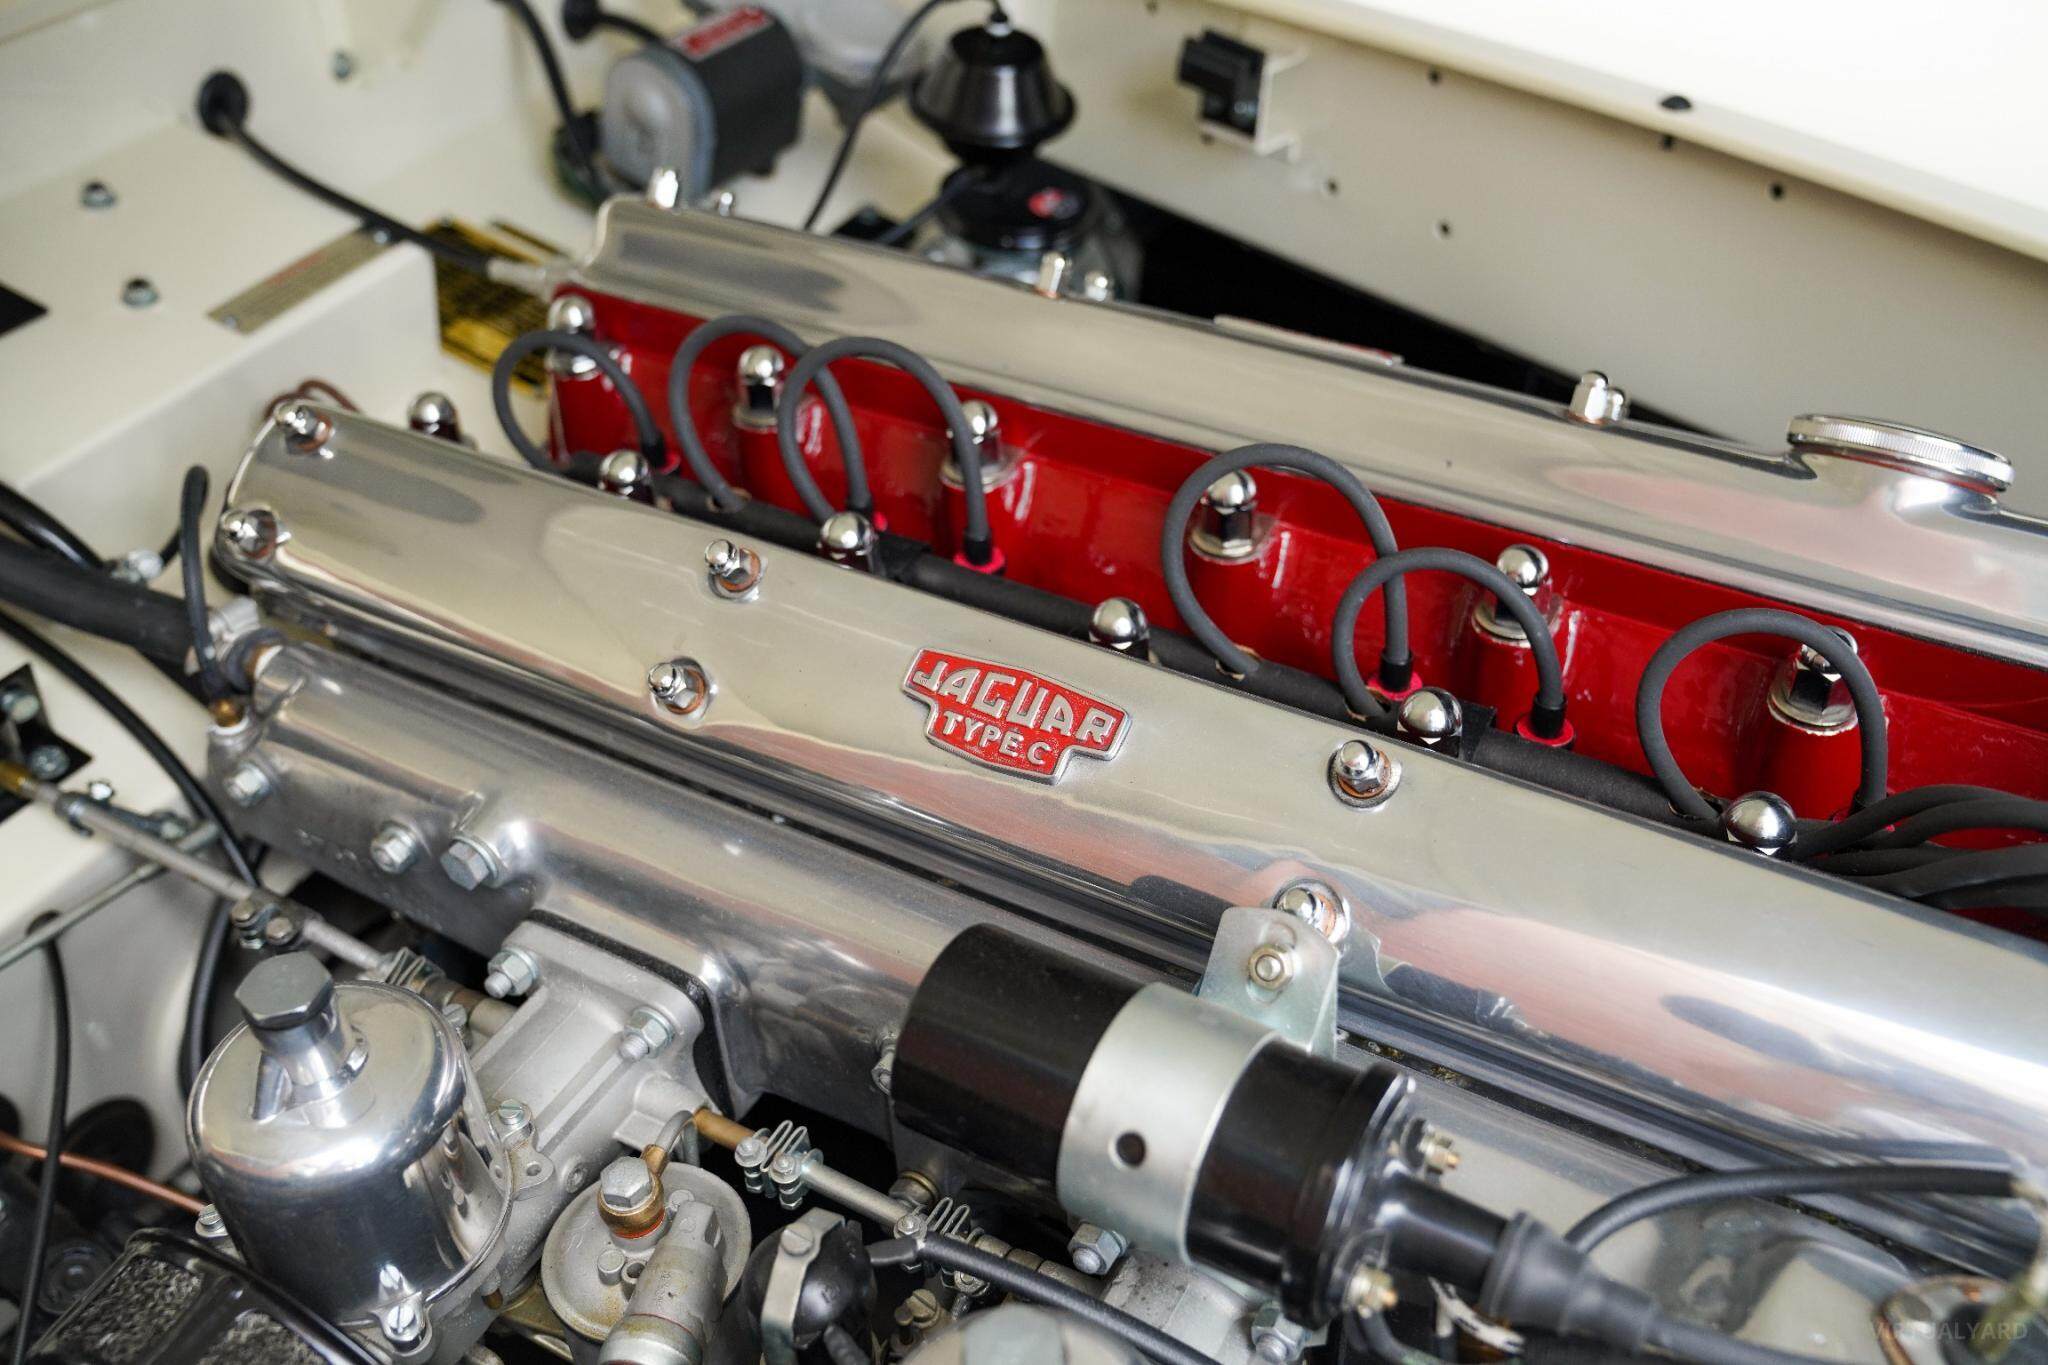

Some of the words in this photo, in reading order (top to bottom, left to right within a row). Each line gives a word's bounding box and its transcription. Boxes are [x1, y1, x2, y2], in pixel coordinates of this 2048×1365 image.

[912, 660, 1117, 744] JAGUAR
[942, 710, 1024, 757] TYPE
[1027, 741, 1052, 766] C
